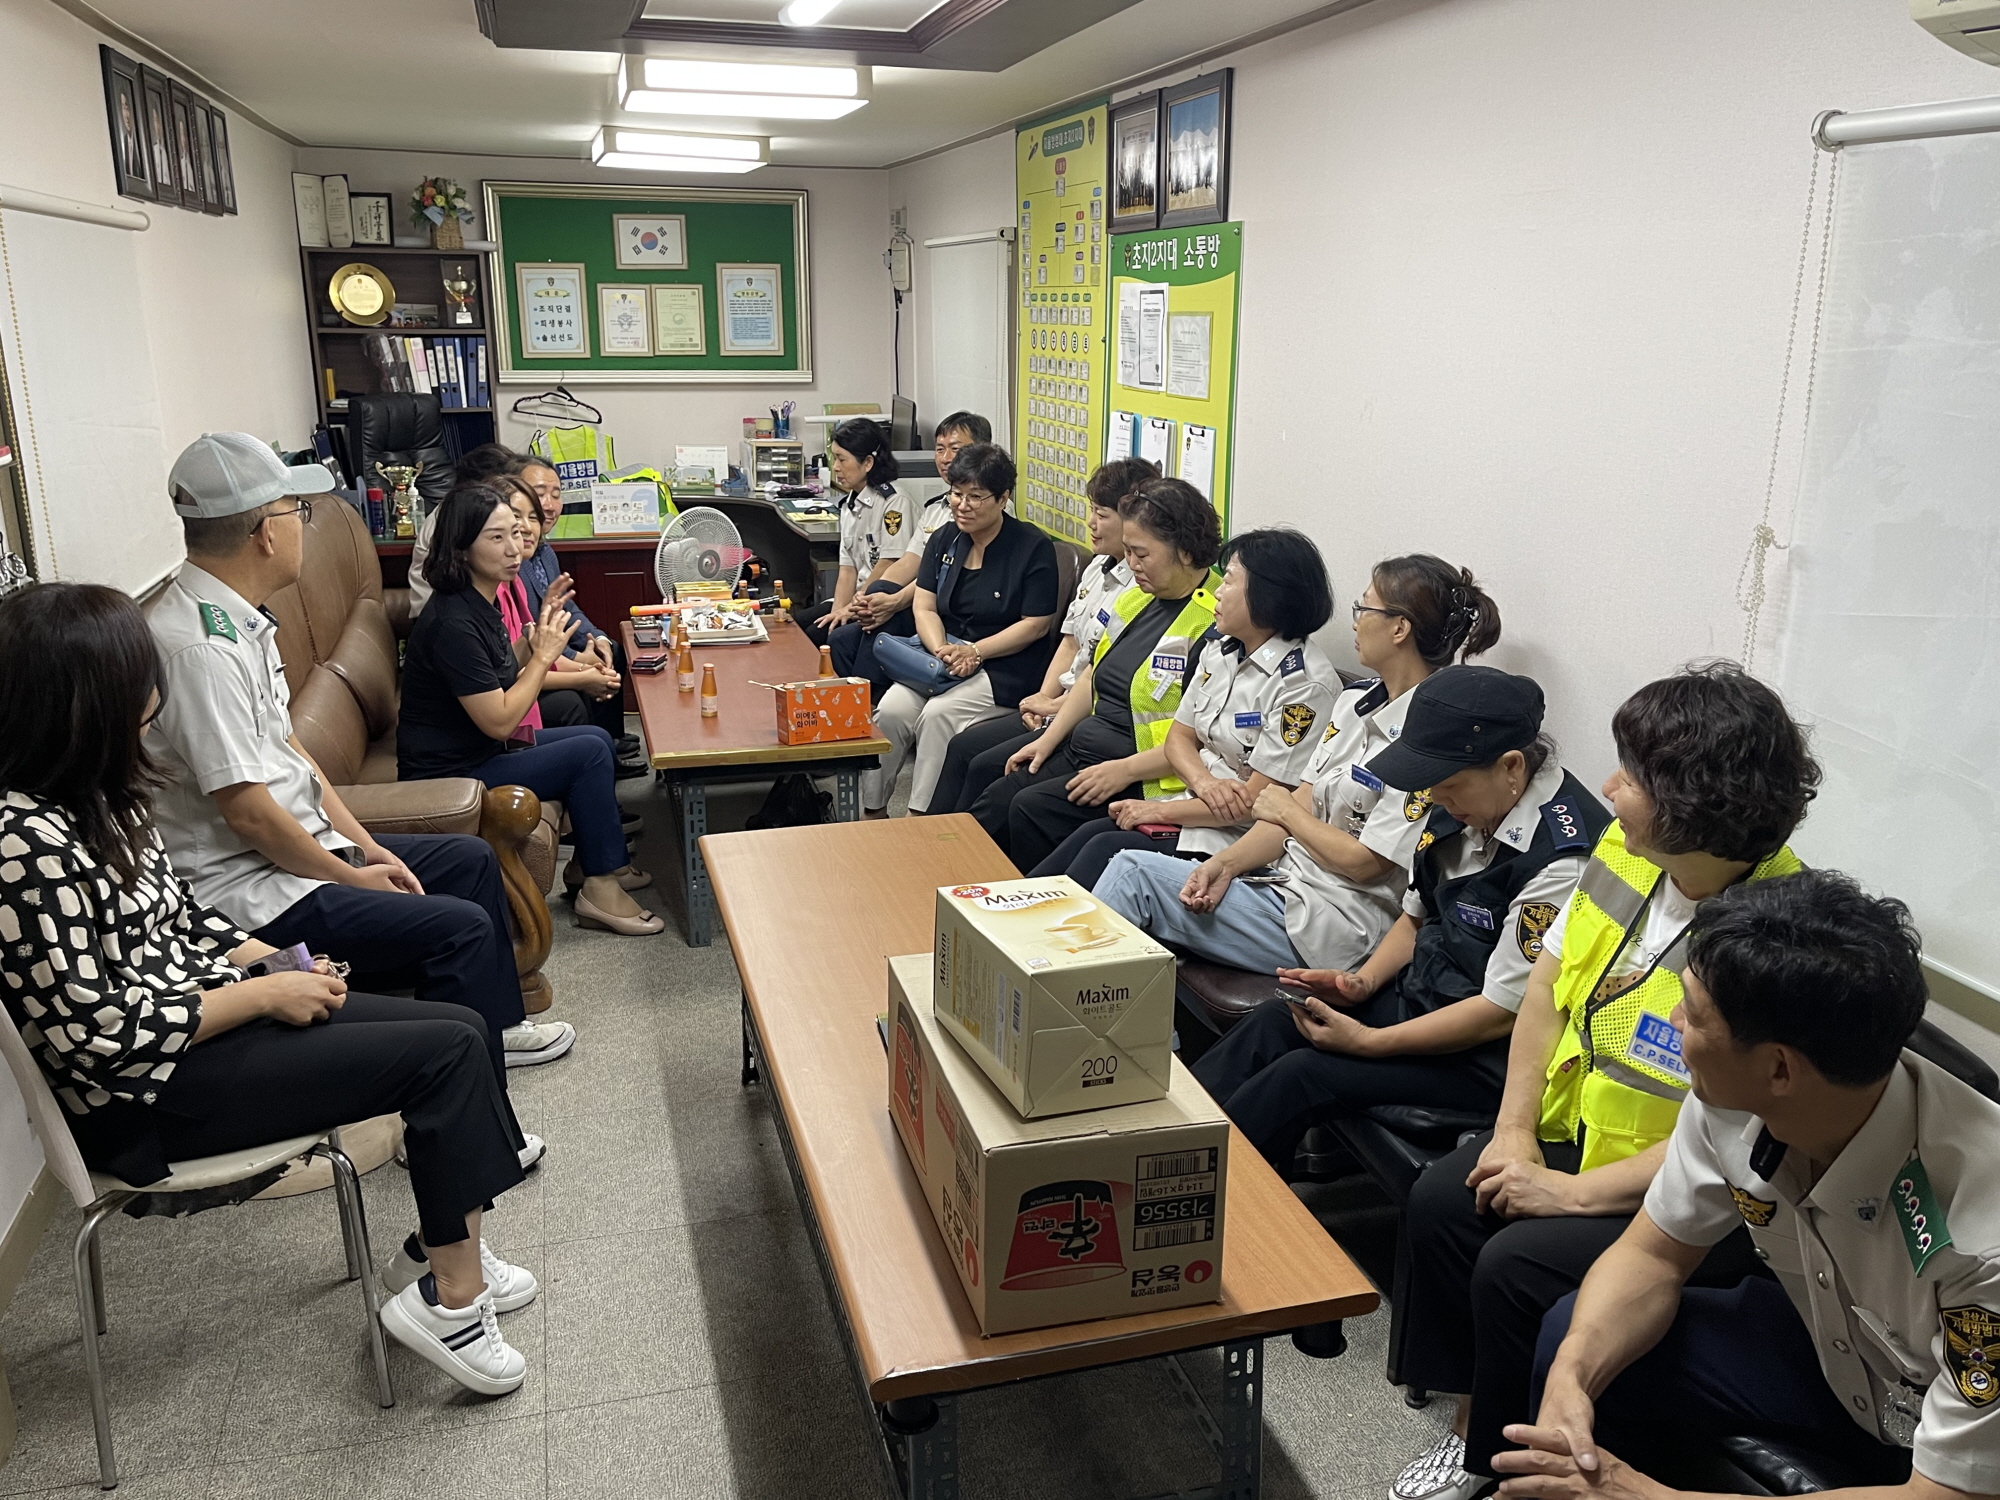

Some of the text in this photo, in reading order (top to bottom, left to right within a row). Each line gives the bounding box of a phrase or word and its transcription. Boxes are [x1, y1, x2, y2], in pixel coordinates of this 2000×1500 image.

[1132, 233, 1221, 271] 초지2지대 소통방
[538, 305, 571, 313] 조직단결
[558, 461, 595, 478] 자율방범
[1154, 656, 1183, 670] 자율방범
[795, 711, 817, 720] 미에로
[796, 719, 818, 728] 화이바
[983, 889, 1069, 906] Maxim
[938, 932, 947, 986] Maxim
[1075, 983, 1129, 1006] Maxim
[1082, 1003, 1123, 1015] 화이트골드
[1643, 1019, 1683, 1051] 자율방
[1081, 1055, 1118, 1078] 200
[1186, 1182, 1204, 1192] 114
[1053, 1193, 1067, 1202] SHIN
[942, 1184, 963, 1253] 농심
[1140, 1198, 1209, 1223] 가3556
[1022, 1217, 1056, 1232] 라면
[1048, 1193, 1100, 1261] 辛
[1131, 1264, 1181, 1288] 농심
[1130, 1283, 1180, 1298] 인생을 맛있게
